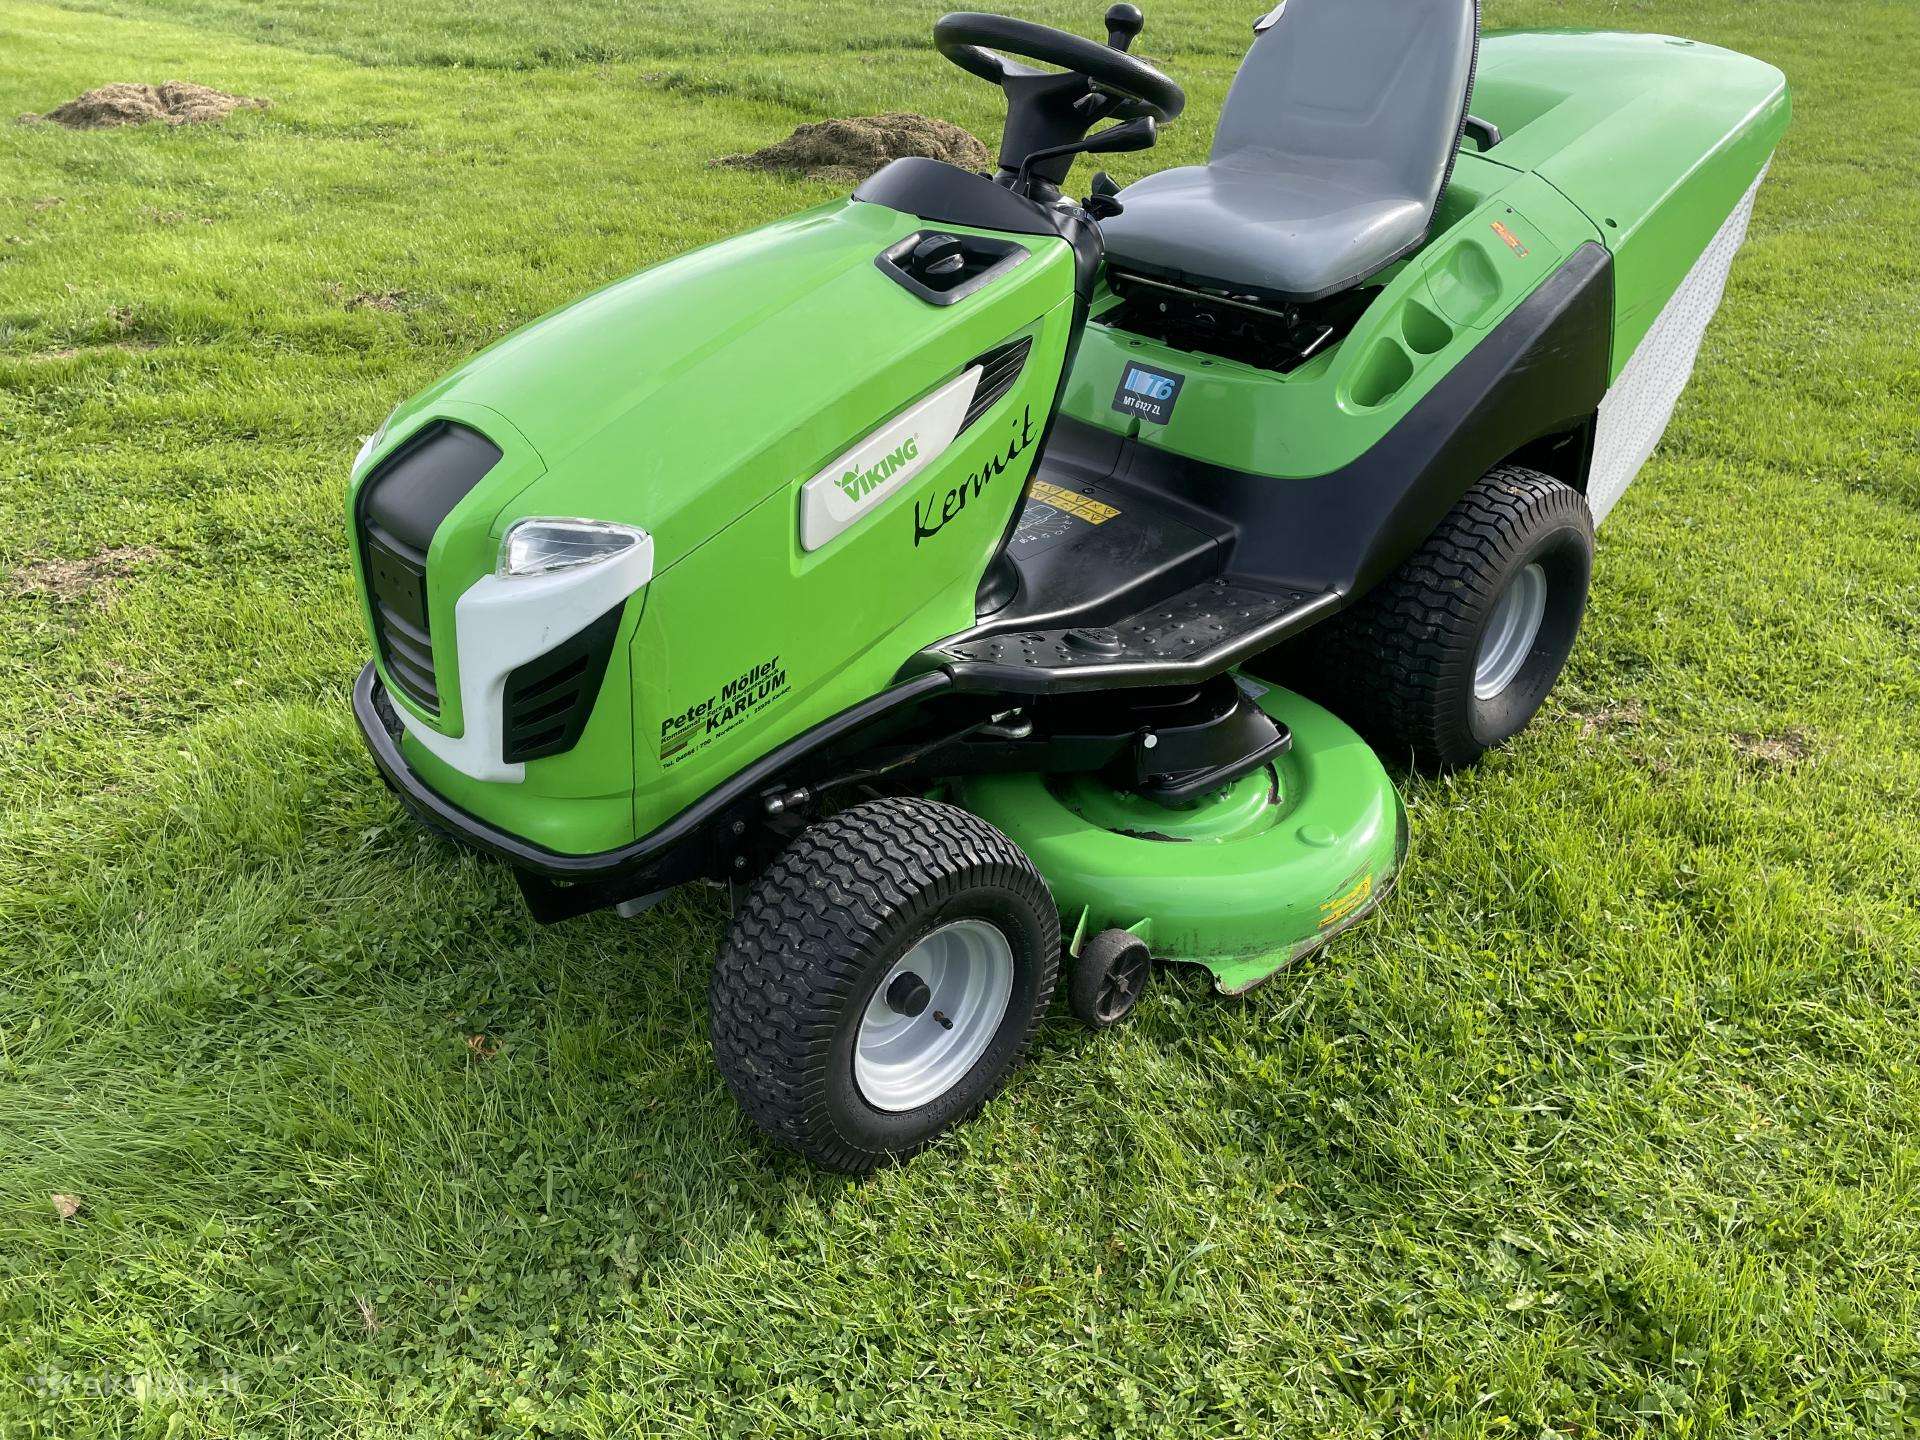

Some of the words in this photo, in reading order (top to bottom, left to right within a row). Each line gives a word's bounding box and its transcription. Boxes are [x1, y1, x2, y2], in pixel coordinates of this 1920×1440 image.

[1123, 395, 1136, 407] MT
[1135, 400, 1152, 412] 6127
[1152, 404, 1161, 416] ZL
[841, 436, 920, 503] VIKING
[914, 403, 1038, 548] Kermit
[661, 695, 716, 738] Peter
[721, 655, 779, 703] Möller
[706, 669, 786, 734] KARLUM
